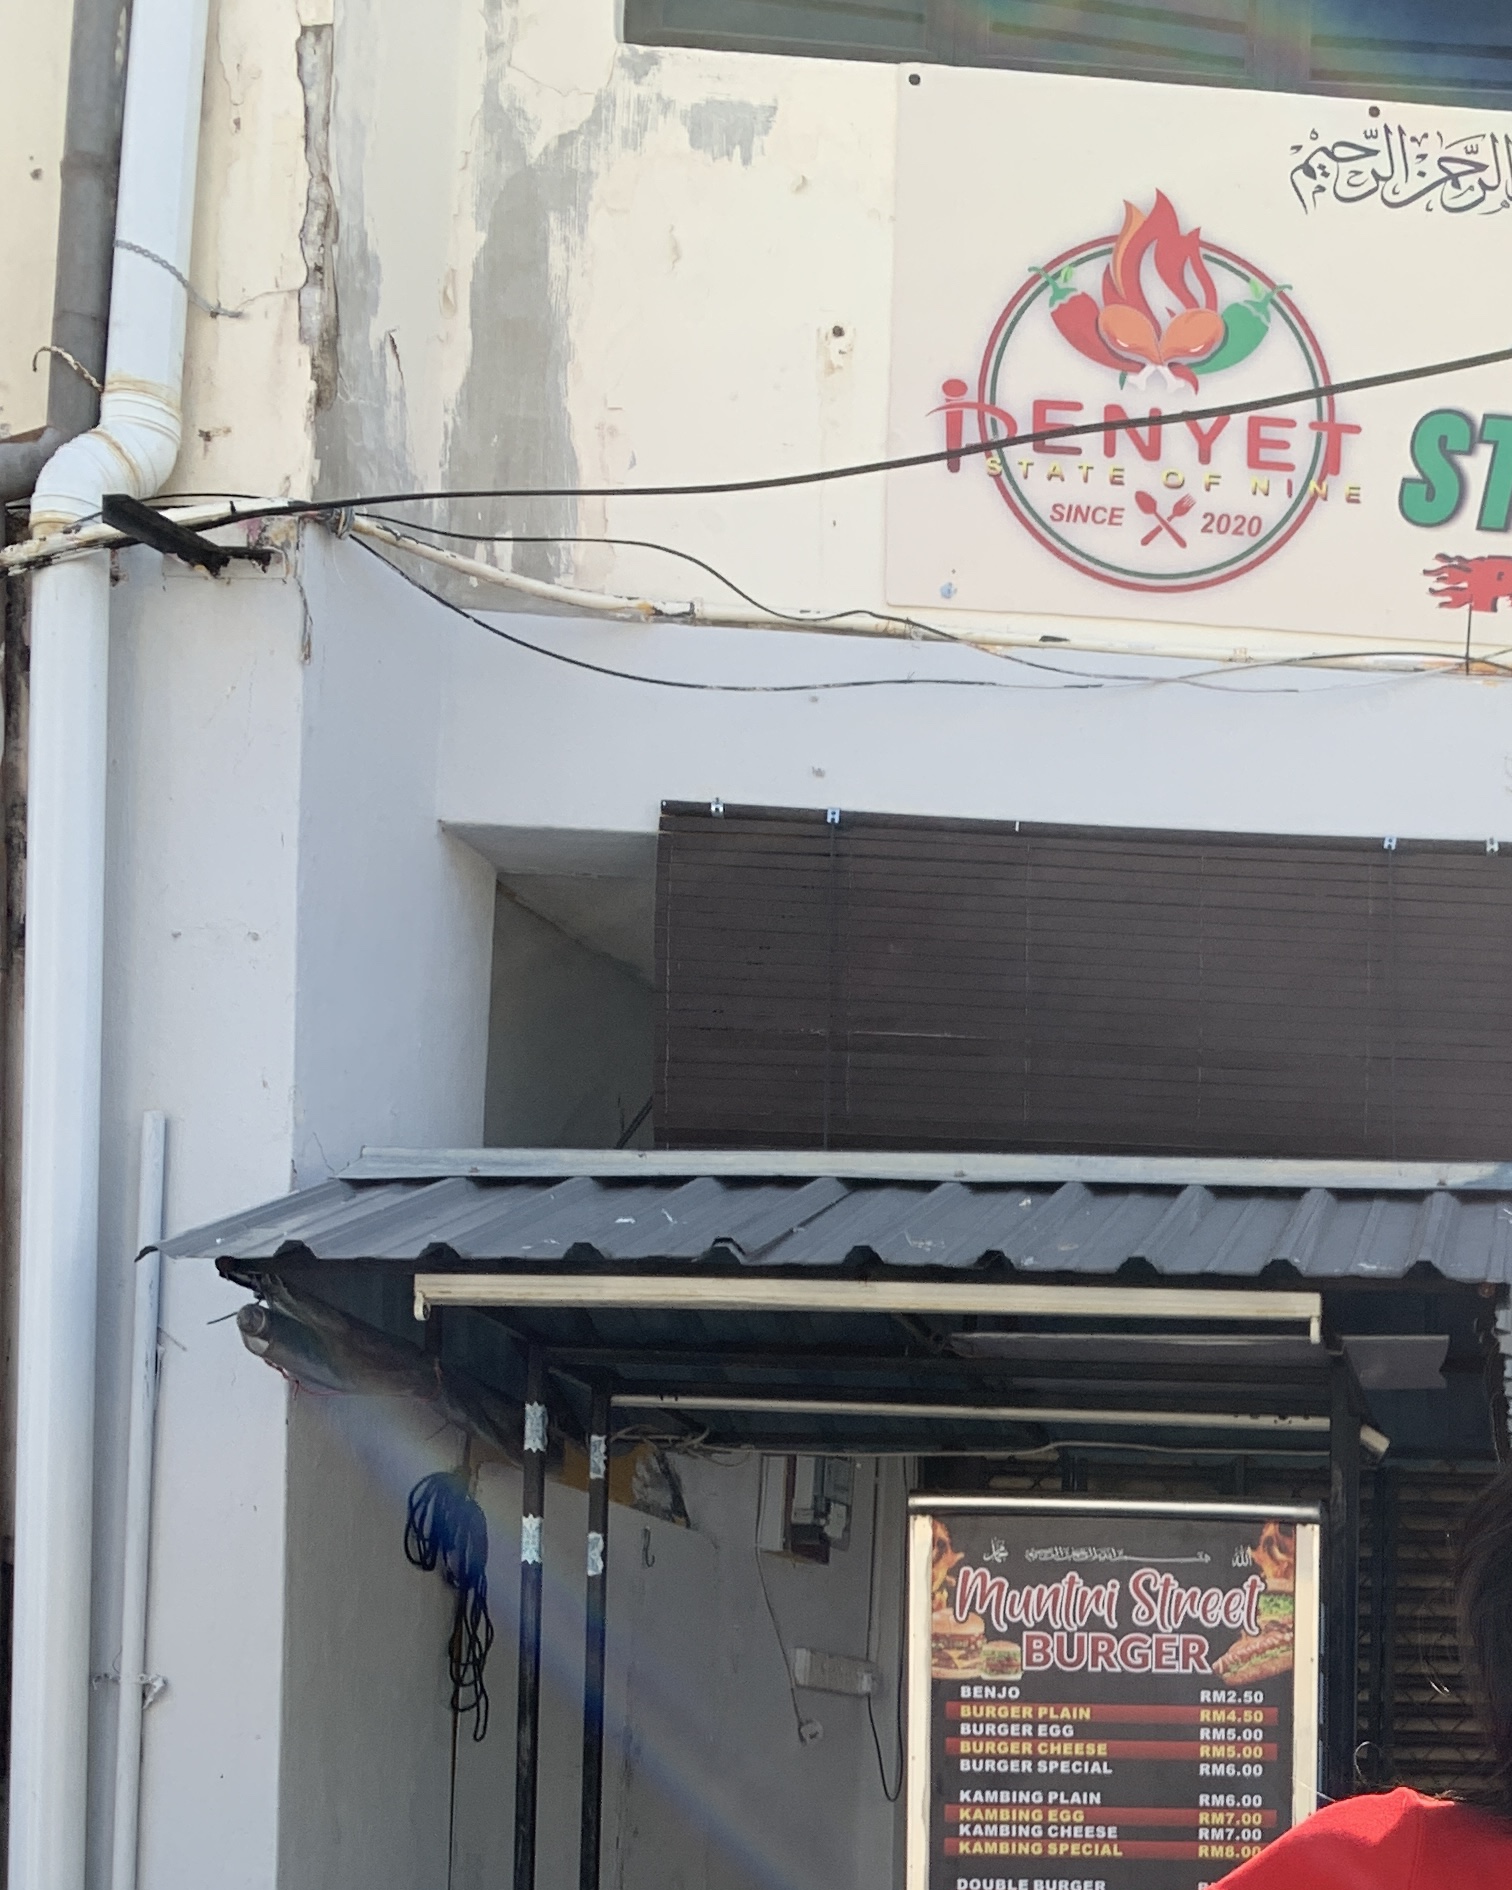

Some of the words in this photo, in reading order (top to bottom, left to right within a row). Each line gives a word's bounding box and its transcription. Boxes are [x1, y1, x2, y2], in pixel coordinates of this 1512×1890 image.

[985, 457, 1126, 486] STATE
[1162, 468, 1221, 494] OF
[1250, 478, 1362, 504] NINE
[1048, 503, 1125, 528] SINCE
[1200, 511, 1263, 538] 2020
[954, 1565, 1120, 1632] Muntri
[1129, 1567, 1265, 1635] Street
[1022, 1631, 1213, 1674] BURGER
[960, 1685, 1021, 1700] BENJO
[1199, 1689, 1264, 1705] RM2.50
[960, 1704, 1034, 1720] BURGER
[1037, 1705, 1091, 1721] PLAIN
[1199, 1708, 1264, 1724] RM4.50
[959, 1722, 1034, 1737] BURGER
[1037, 1723, 1075, 1738] EGG
[1199, 1727, 1264, 1742] RM5.00
[959, 1740, 1033, 1756] BURGER
[1036, 1741, 1108, 1757] CHEESE
[1199, 1744, 1264, 1761] RM5.00
[959, 1758, 1033, 1774] BURGER
[1036, 1759, 1113, 1775] SPECIAL
[1198, 1762, 1263, 1778] RM6.00
[959, 1789, 1044, 1805] KAMBING
[1047, 1790, 1102, 1805] PLAIN
[1198, 1793, 1263, 1808] RM6.00
[959, 1807, 1044, 1823] KAMBING
[1047, 1808, 1085, 1823] EGG
[1198, 1811, 1263, 1827] RM7.00
[958, 1823, 1044, 1838] KAMBING
[1047, 1824, 1118, 1839] CHEESE
[1198, 1827, 1262, 1842] RM7.00
[958, 1840, 1043, 1856] KAMBING
[1047, 1842, 1124, 1857] SPECIAL
[1198, 1844, 1262, 1858] RM8.00
